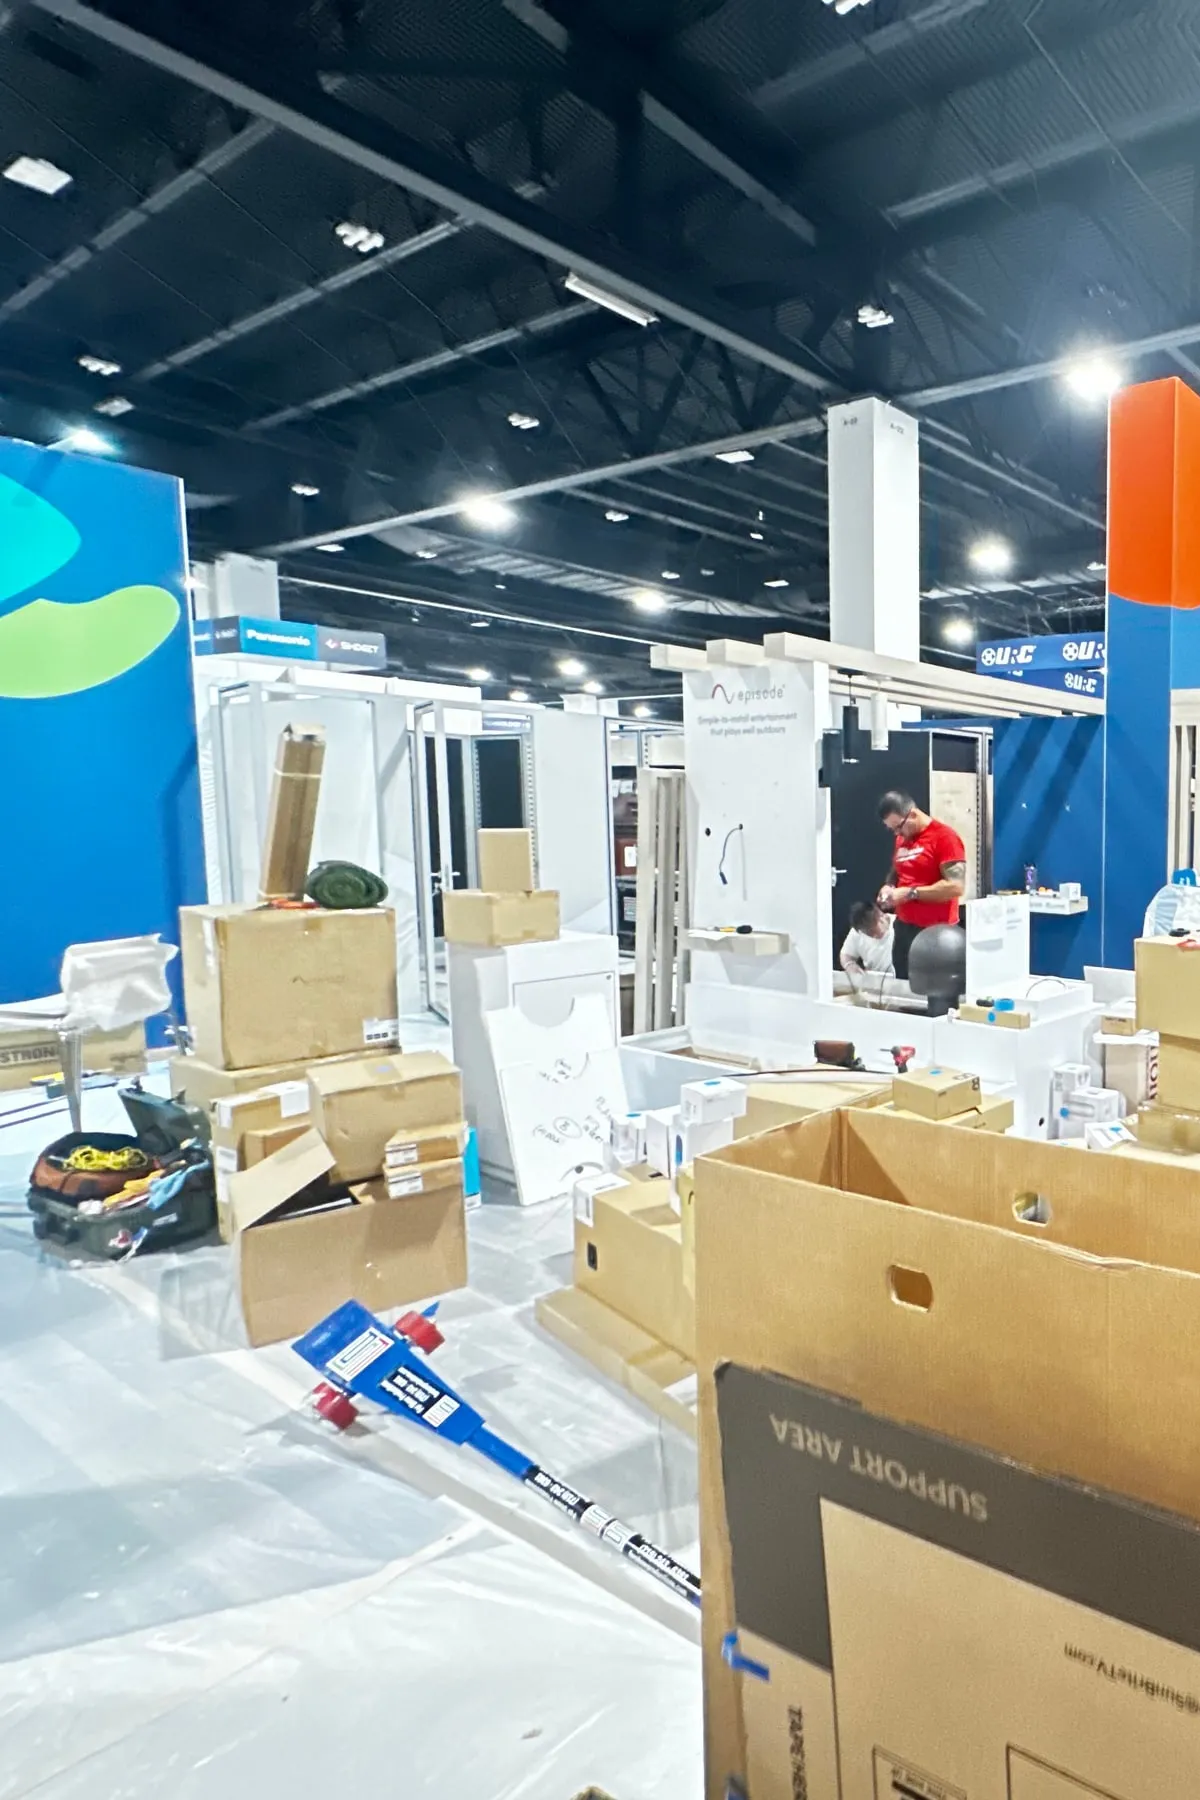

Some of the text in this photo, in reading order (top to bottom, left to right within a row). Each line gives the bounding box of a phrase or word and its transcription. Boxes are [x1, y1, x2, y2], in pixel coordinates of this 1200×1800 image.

[246, 629, 311, 647] Panasonic
[1078, 640, 1105, 660] UR
[737, 685, 784, 704] episode
[0, 1046, 55, 1064] STRON
[769, 1412, 988, 1523] SUPPORT AREA
[791, 1757, 808, 1800] HER
